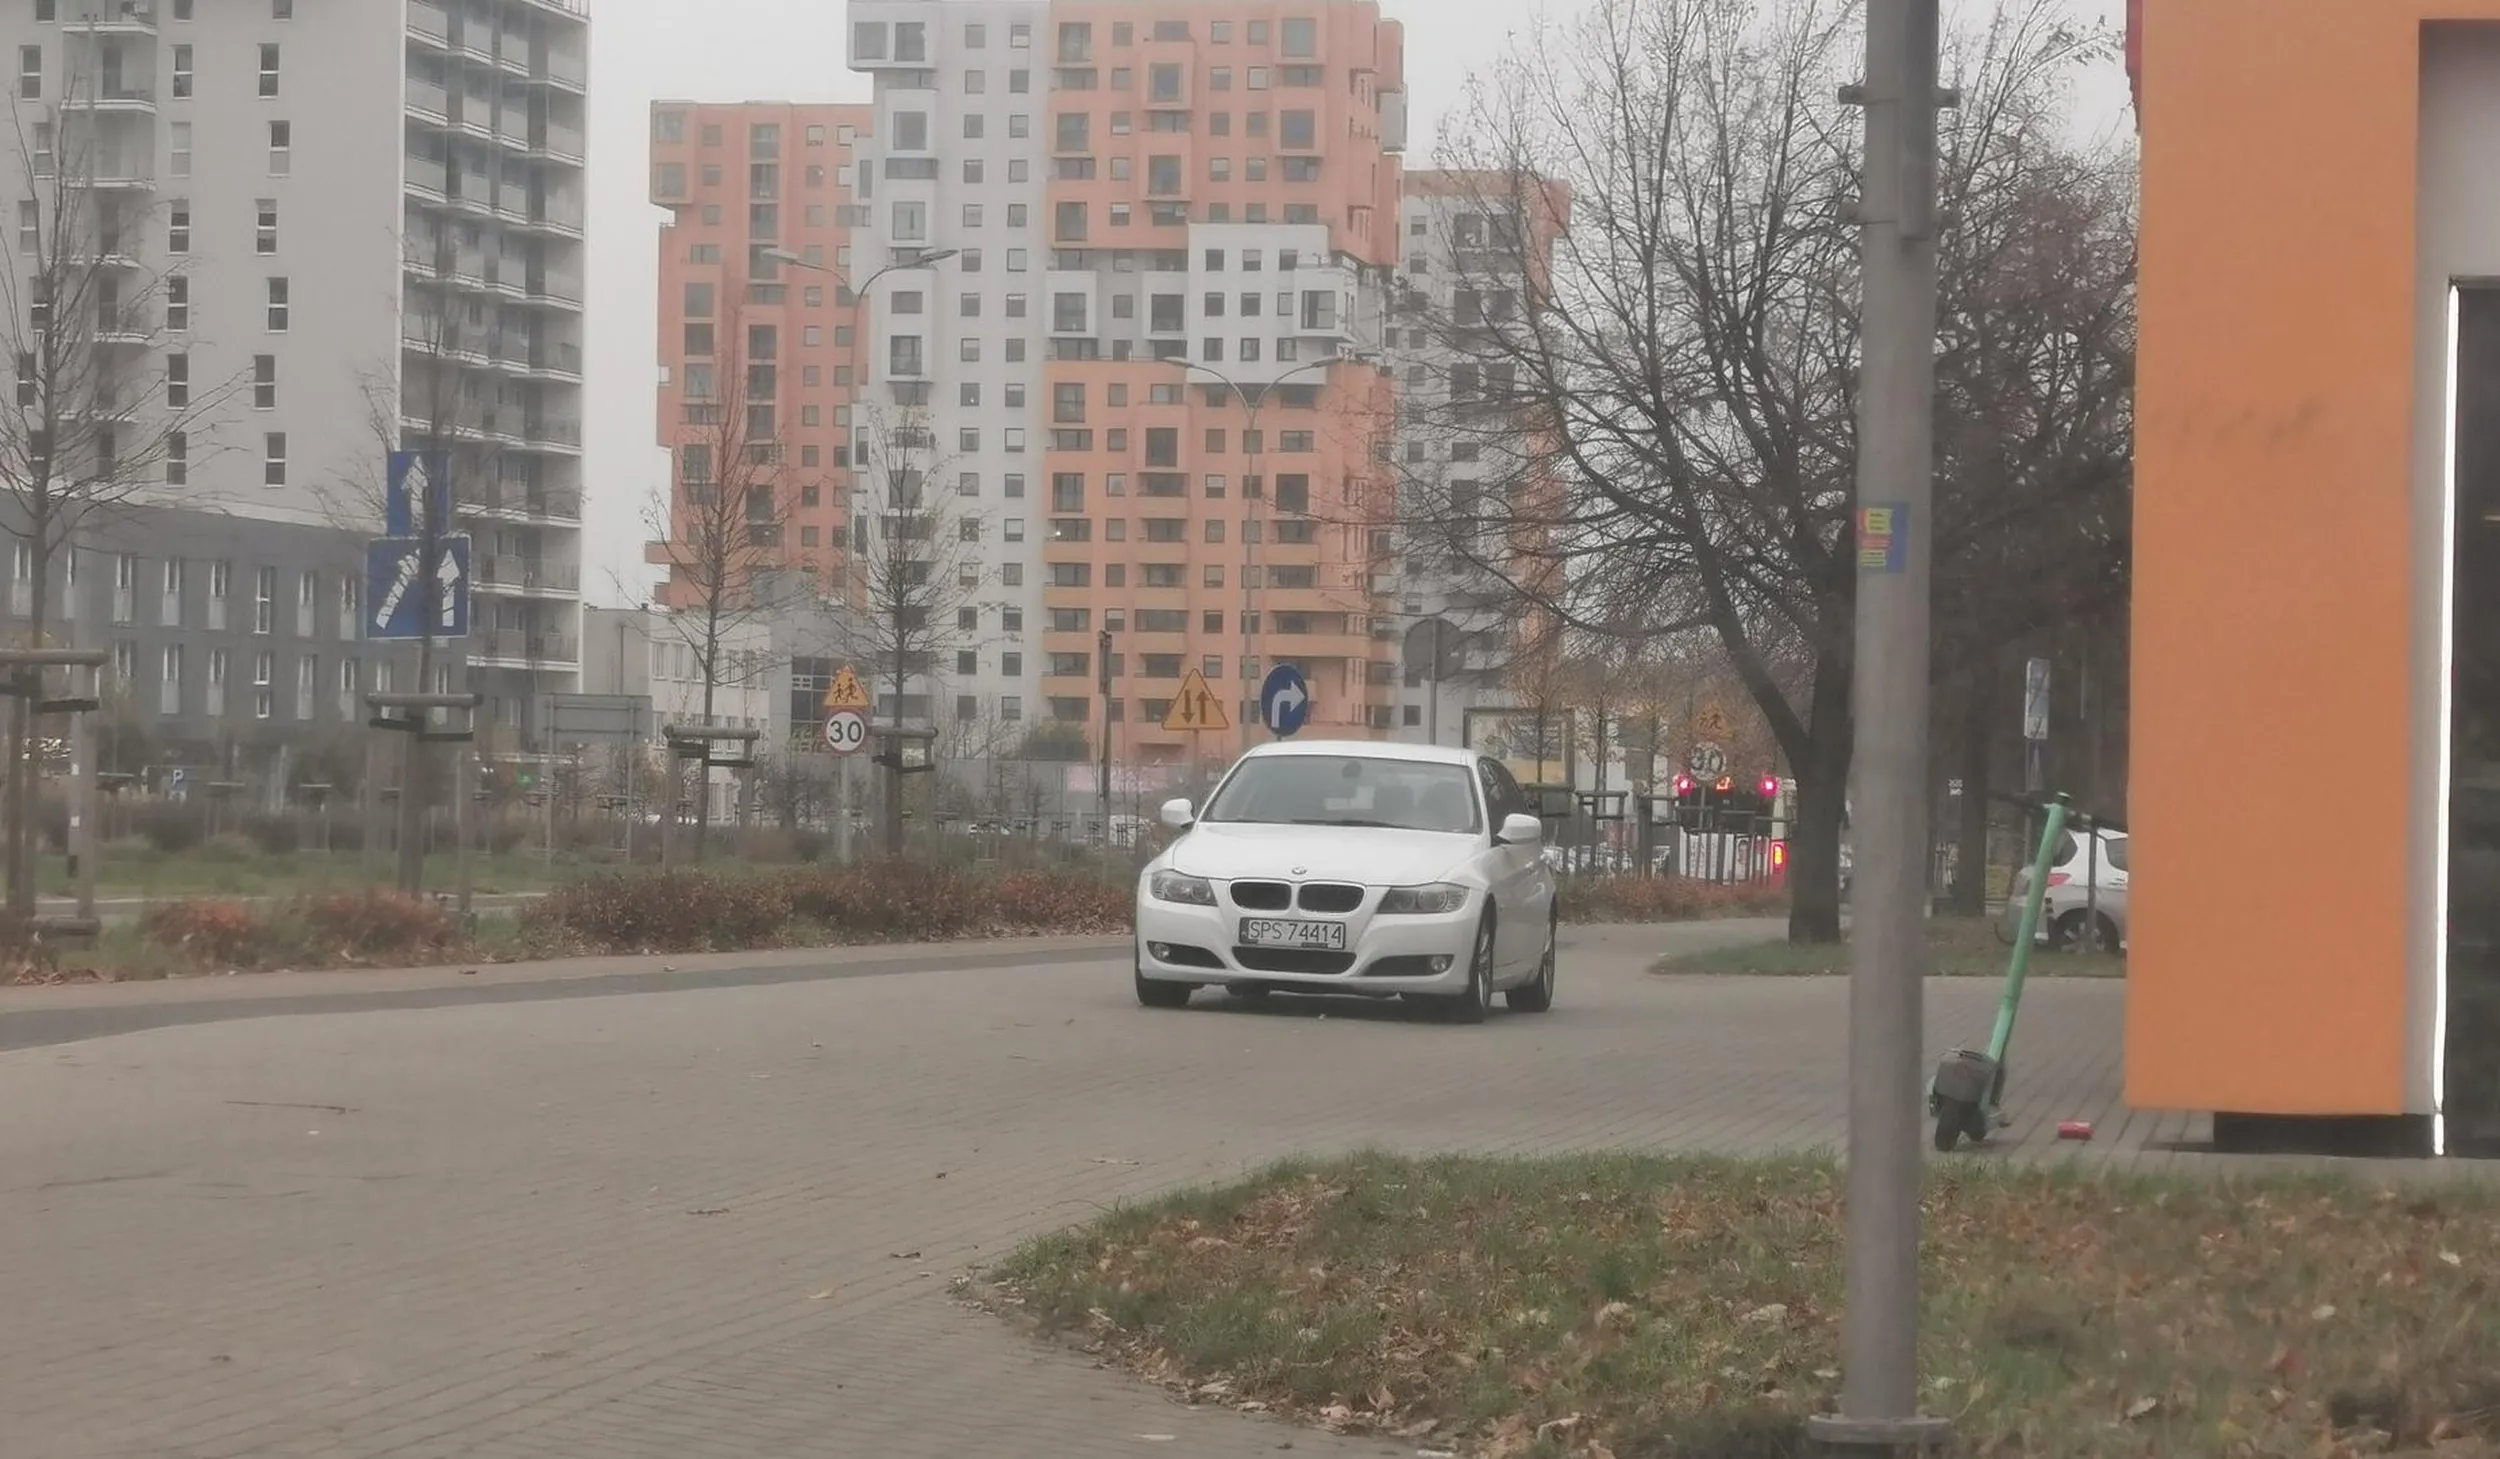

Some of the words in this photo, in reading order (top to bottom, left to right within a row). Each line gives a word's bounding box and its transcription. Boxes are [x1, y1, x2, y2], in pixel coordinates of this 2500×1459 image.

[830, 720, 862, 743] 30
[1691, 747, 1723, 773] 30
[172, 769, 184, 786] P
[1250, 921, 1282, 940] SPS
[1288, 922, 1342, 944] 74414
